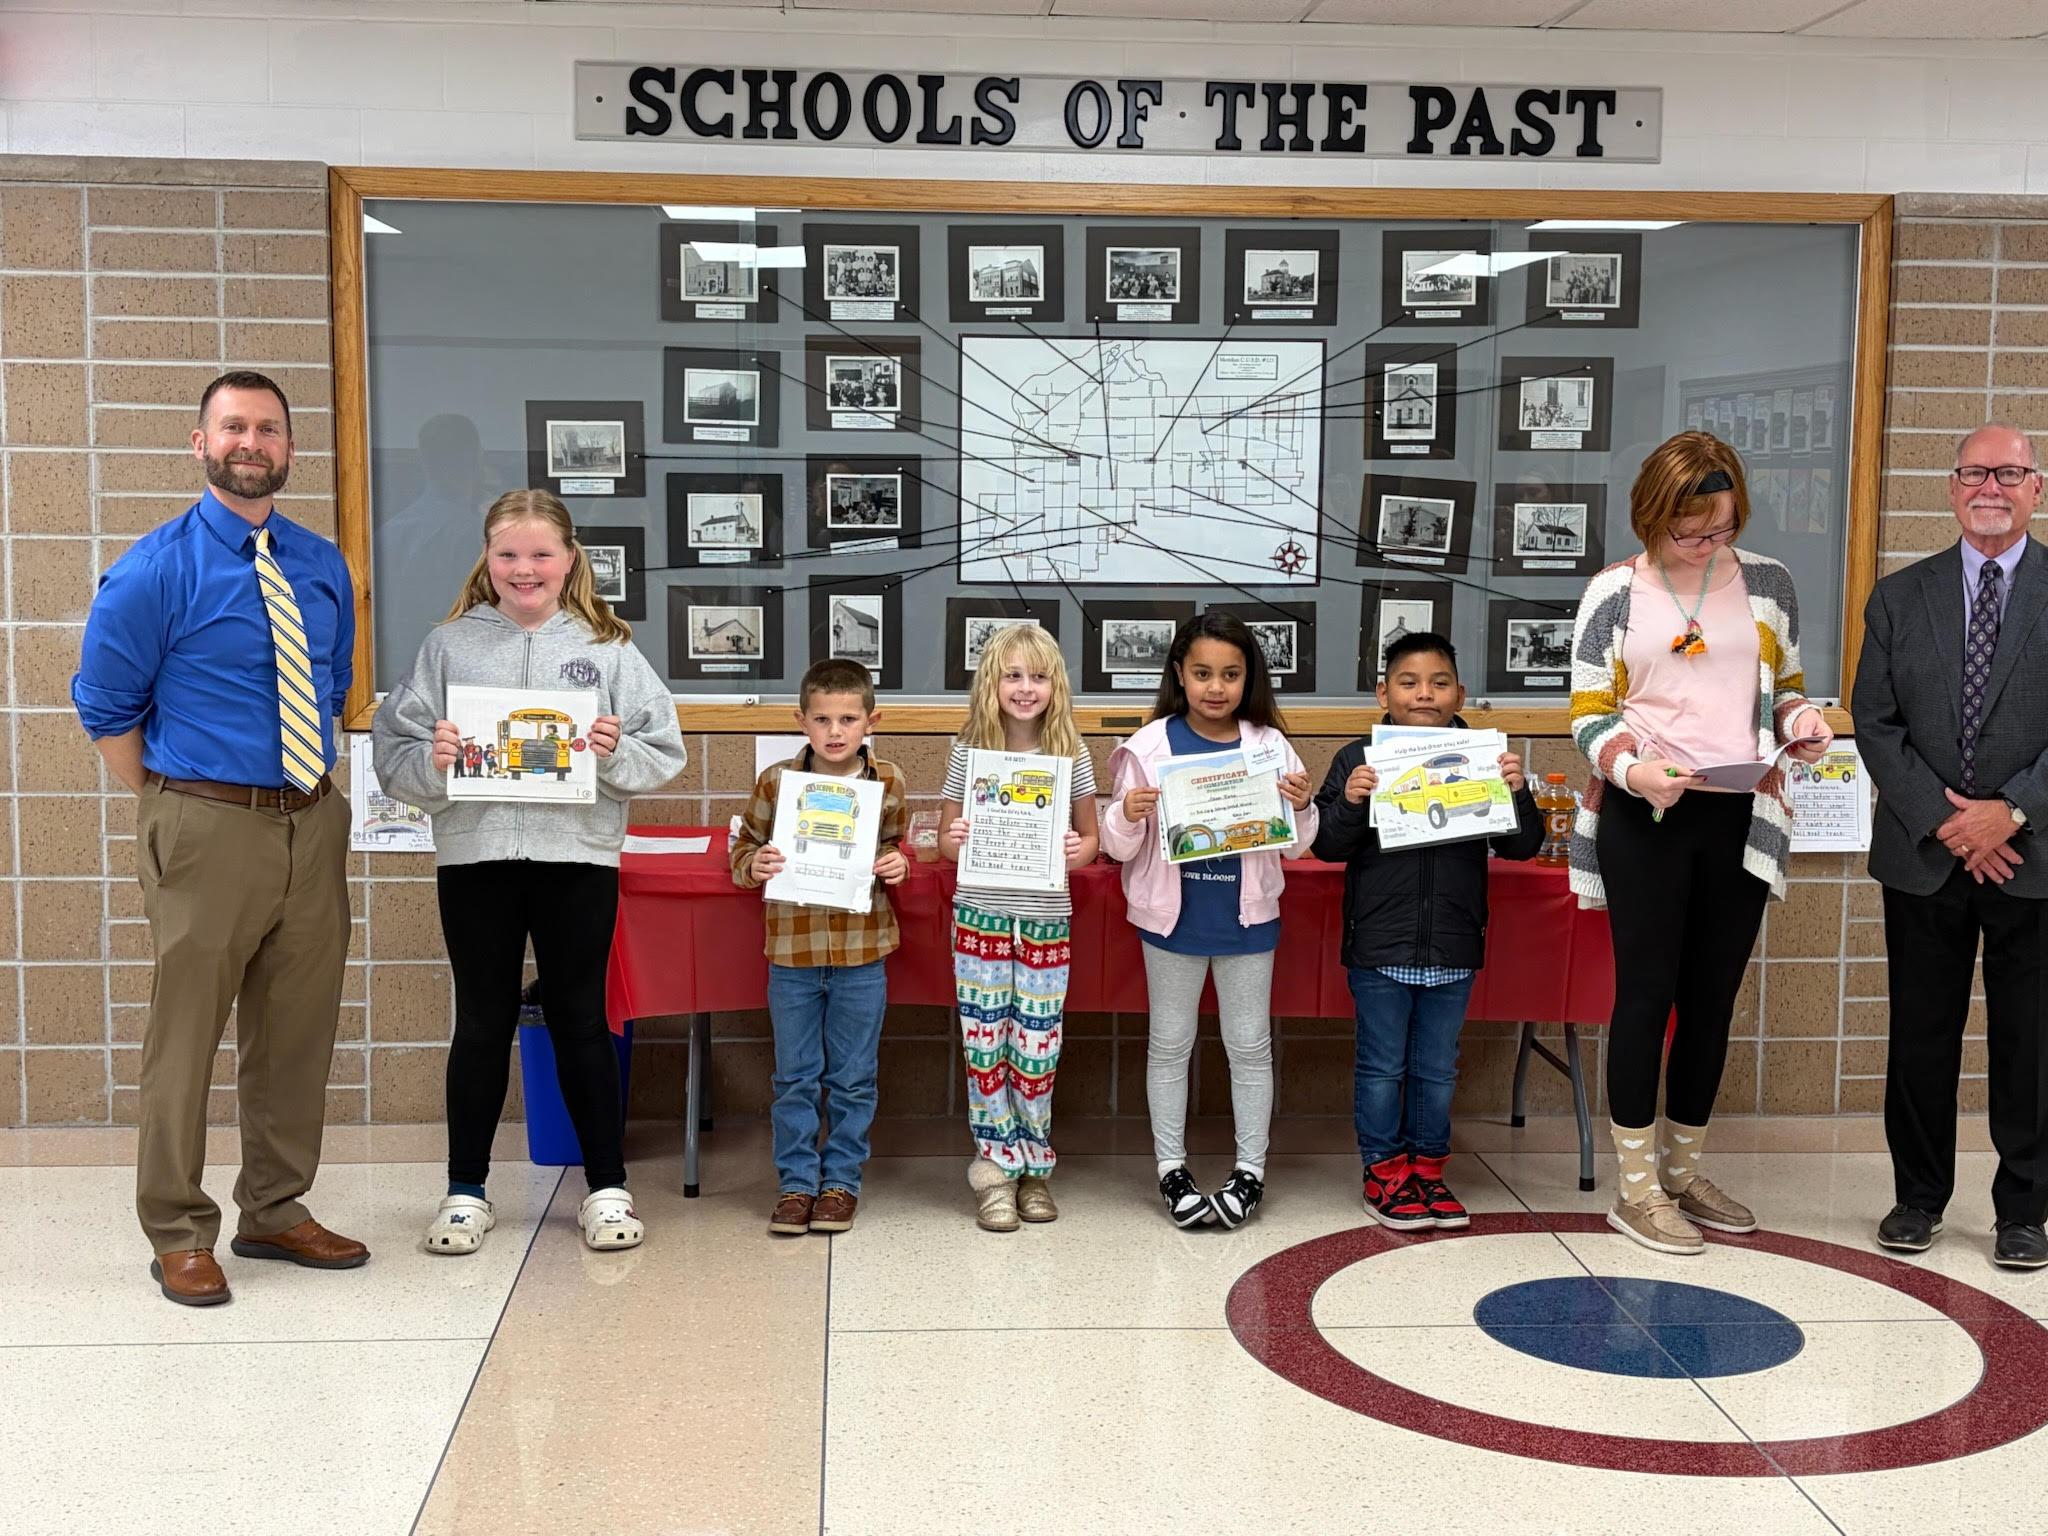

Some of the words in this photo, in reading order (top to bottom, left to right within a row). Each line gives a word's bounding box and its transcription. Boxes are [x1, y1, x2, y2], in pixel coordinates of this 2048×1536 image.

[625, 66, 1020, 147] SCHOOLS
[1063, 79, 1163, 150] OF
[1205, 81, 1368, 153] THE
[1406, 85, 1617, 158] PAST
[815, 783, 834, 793] SCHOOL
[836, 785, 846, 794] BUS
[1550, 814, 1568, 833] G
[1181, 870, 1201, 880] LOVE
[1202, 873, 1237, 883] BLOOMS
